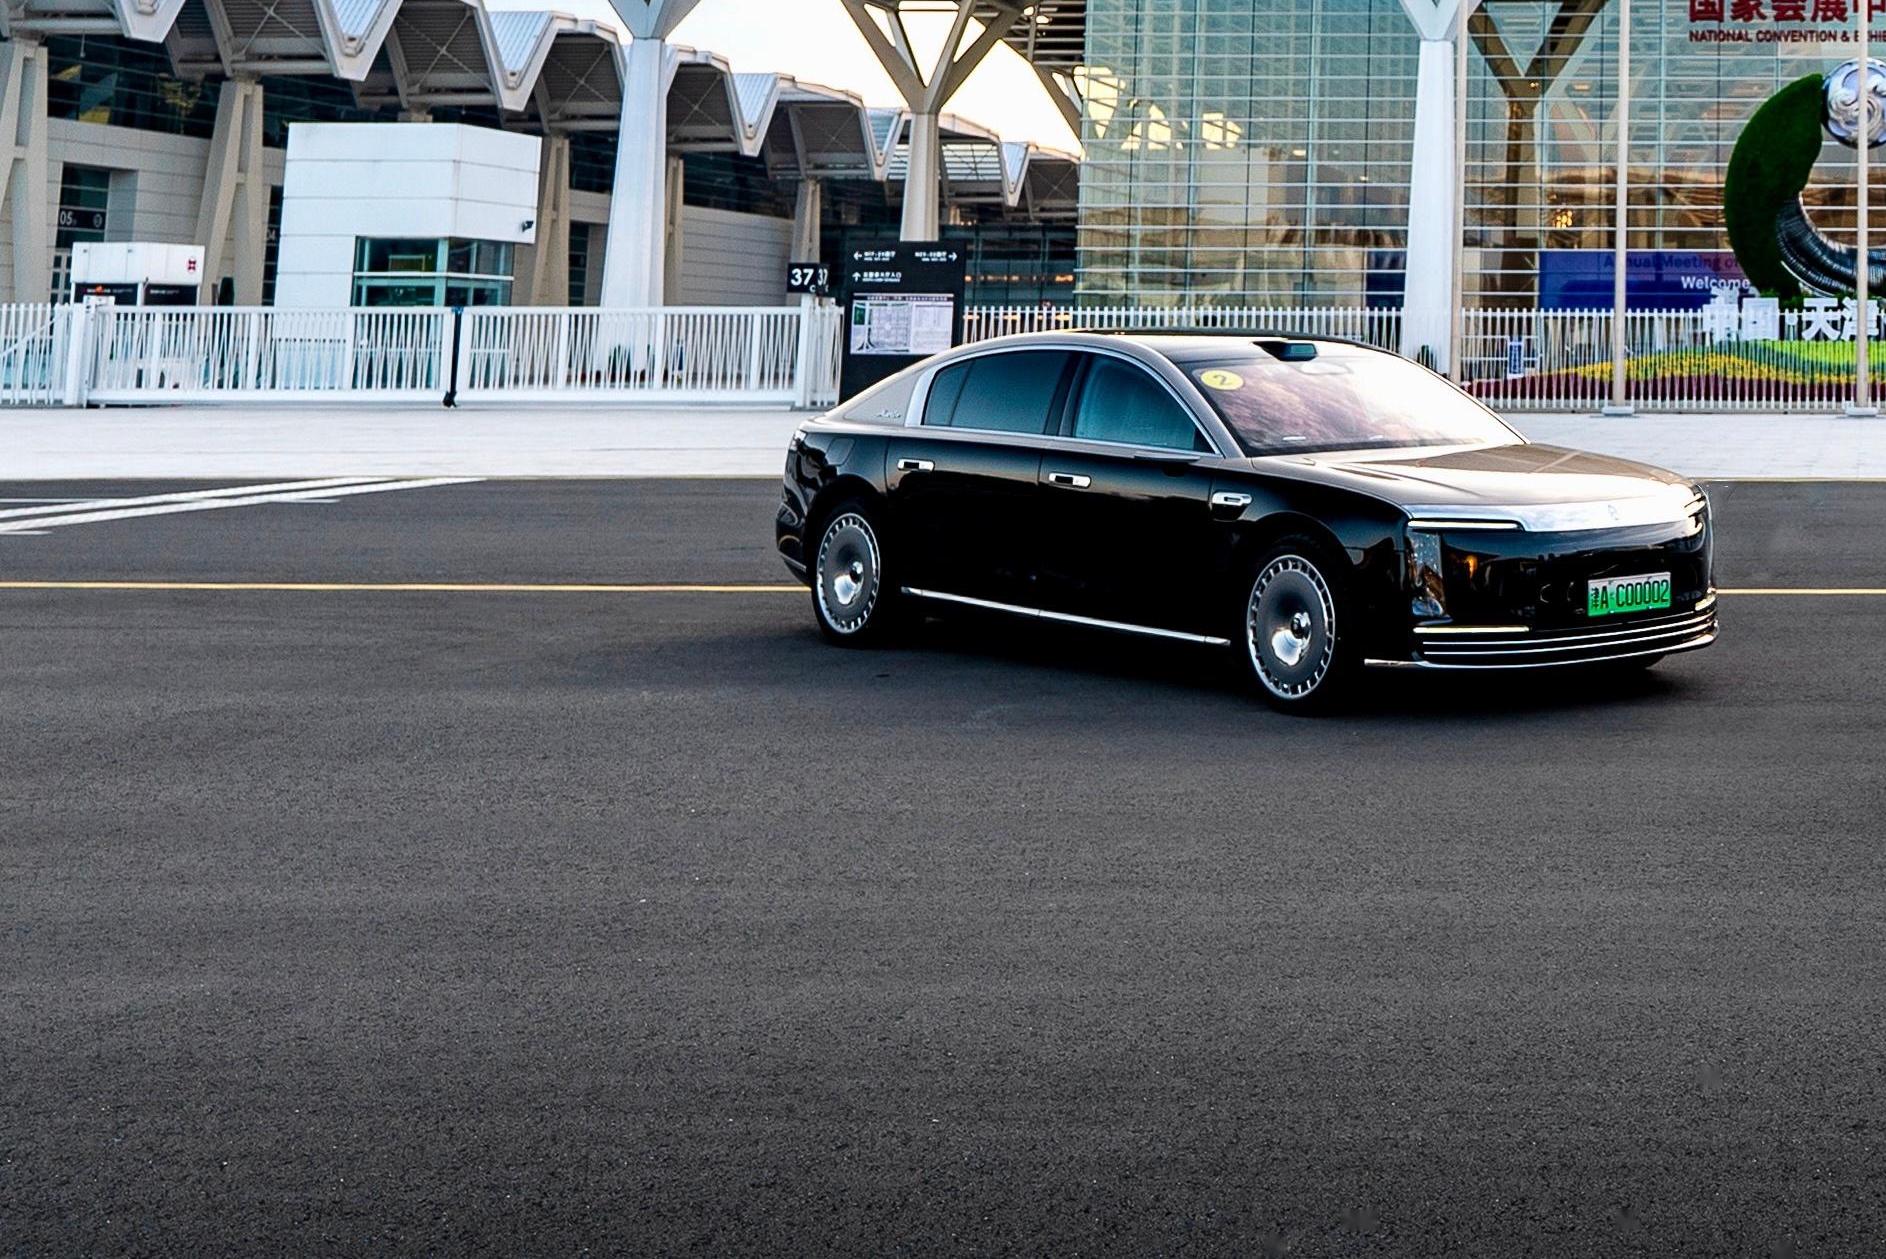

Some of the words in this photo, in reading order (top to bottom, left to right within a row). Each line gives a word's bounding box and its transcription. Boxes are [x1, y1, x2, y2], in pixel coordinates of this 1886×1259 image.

[1689, 30, 1752, 43] NATIONAL
[1756, 30, 1837, 43] CONVENTION
[1840, 30, 1849, 42] &
[790, 268, 814, 286] 37
[1681, 275, 1750, 290] Welcome
